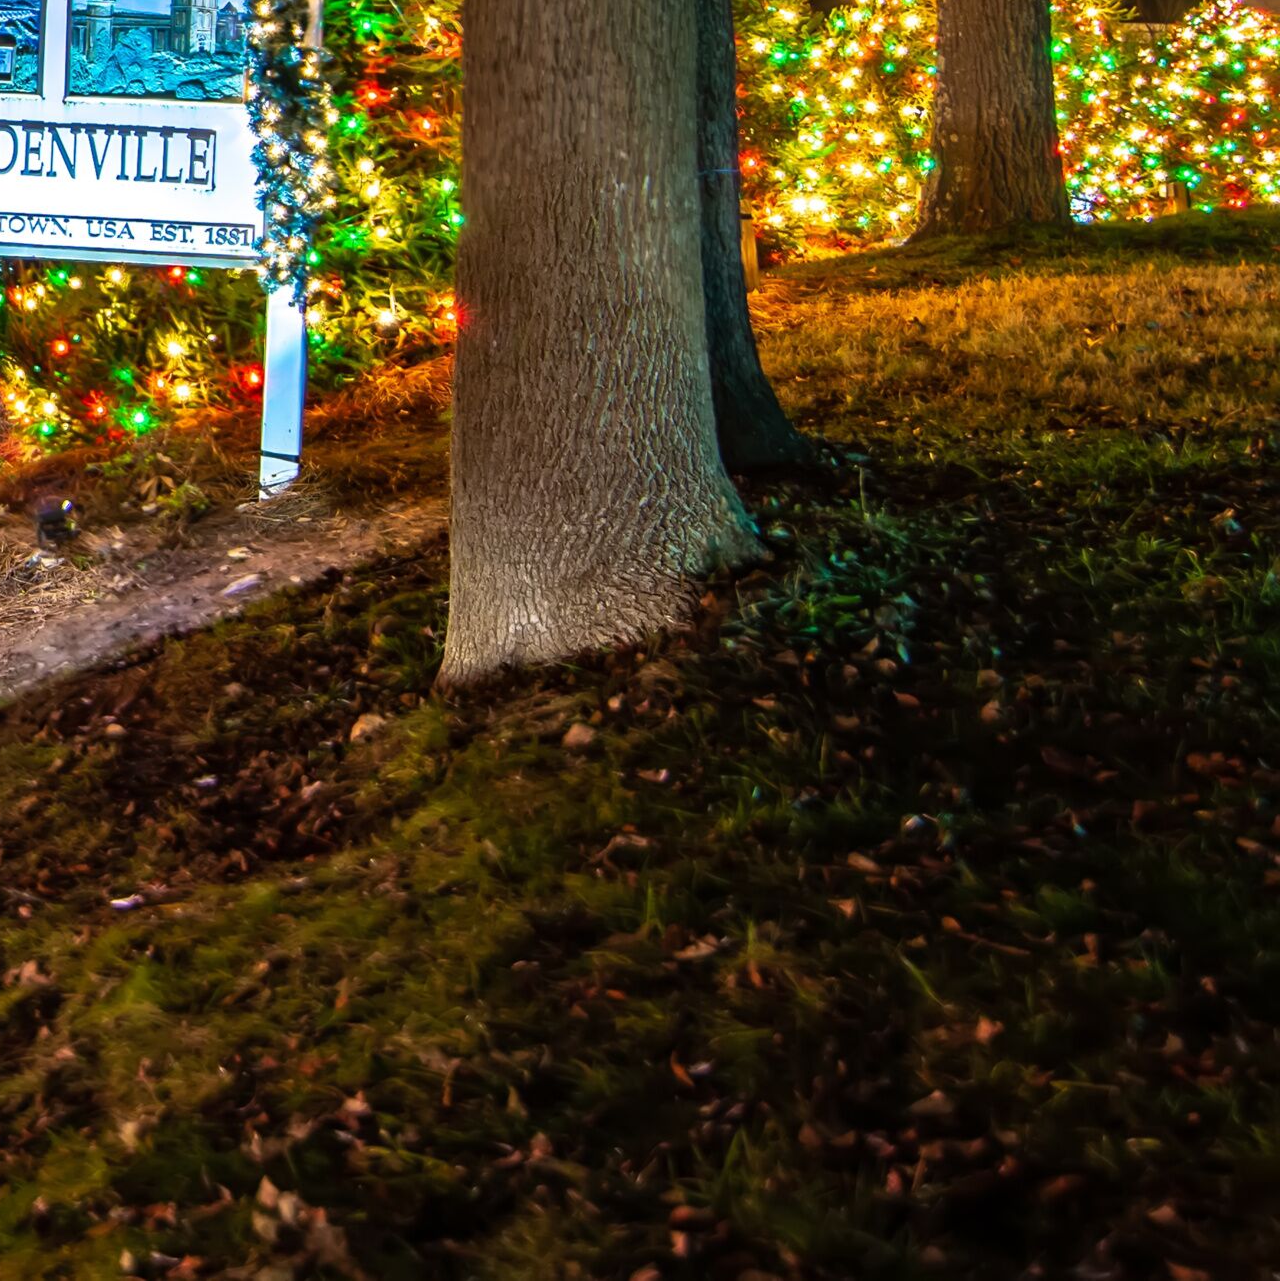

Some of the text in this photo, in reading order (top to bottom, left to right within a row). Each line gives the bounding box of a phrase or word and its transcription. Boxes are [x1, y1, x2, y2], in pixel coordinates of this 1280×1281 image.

[86, 218, 135, 240] USA
[150, 222, 194, 244] EST.
[204, 226, 250, 247] 1881
